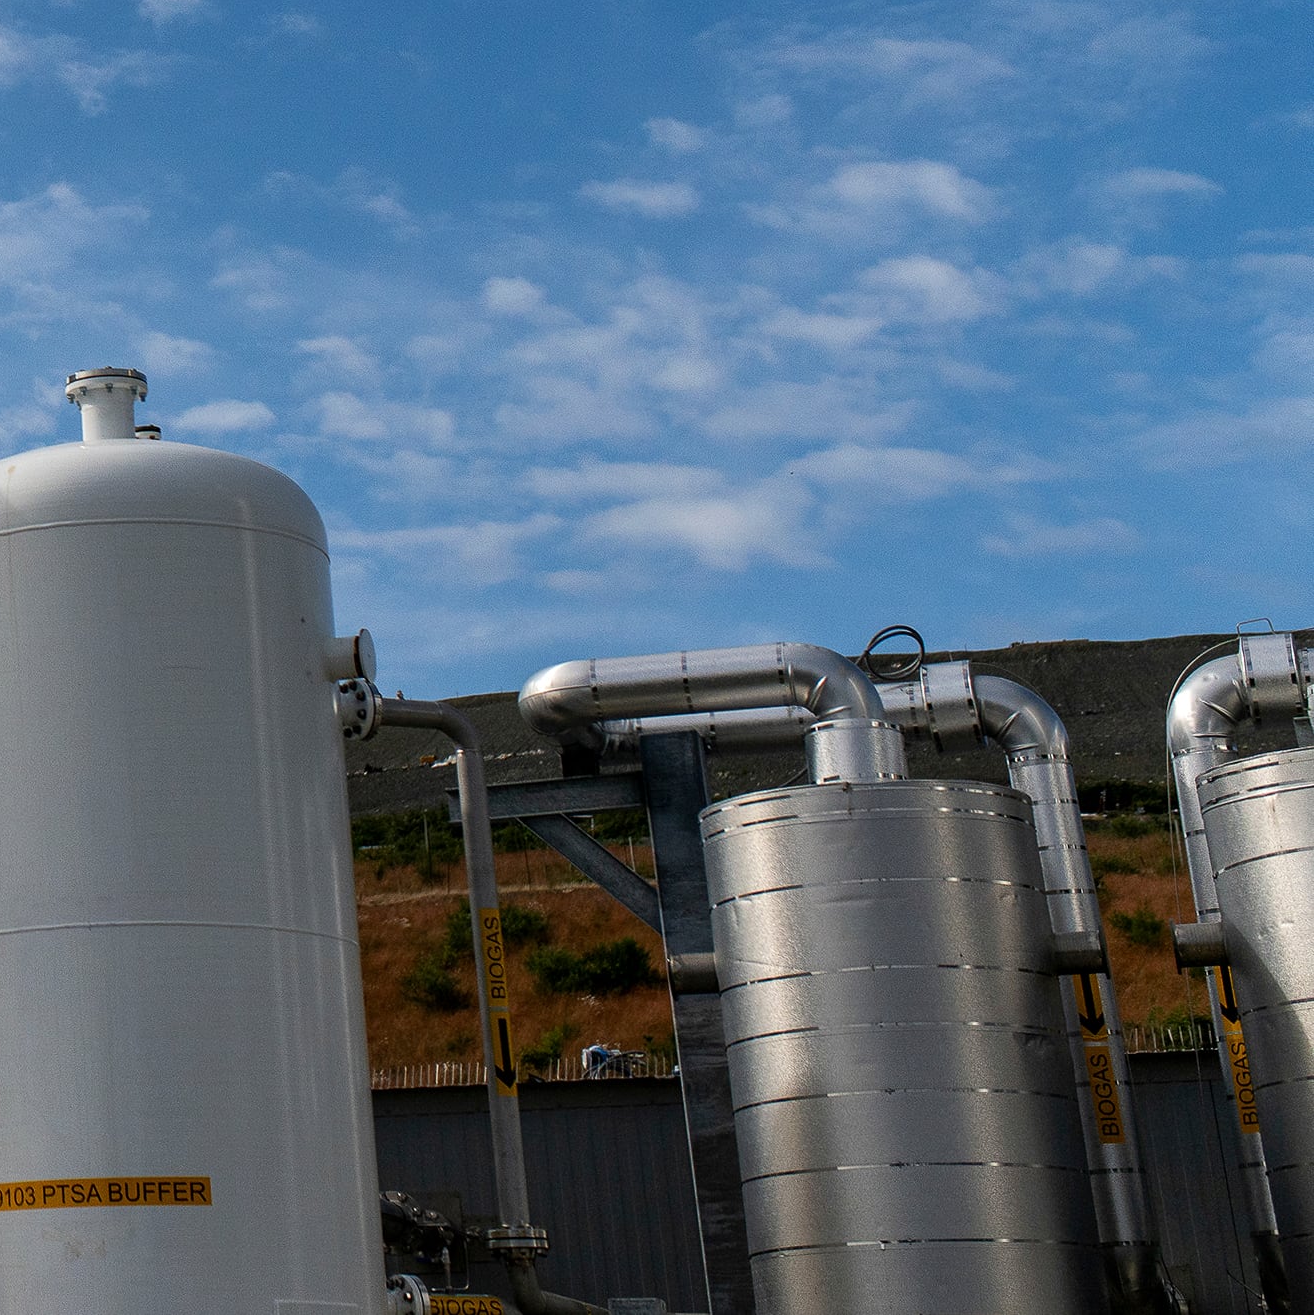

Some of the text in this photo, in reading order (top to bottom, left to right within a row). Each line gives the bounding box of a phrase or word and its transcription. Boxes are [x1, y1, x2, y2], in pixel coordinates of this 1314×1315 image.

[484, 916, 506, 1000] BIOGAS
[1090, 1053, 1120, 1136] BIOGAS
[1231, 1042, 1259, 1125] BIOGAS
[42, 1183, 102, 1205] PTSA
[108, 1181, 208, 1203] BUFFER
[430, 1299, 502, 1315] BIOGAS
